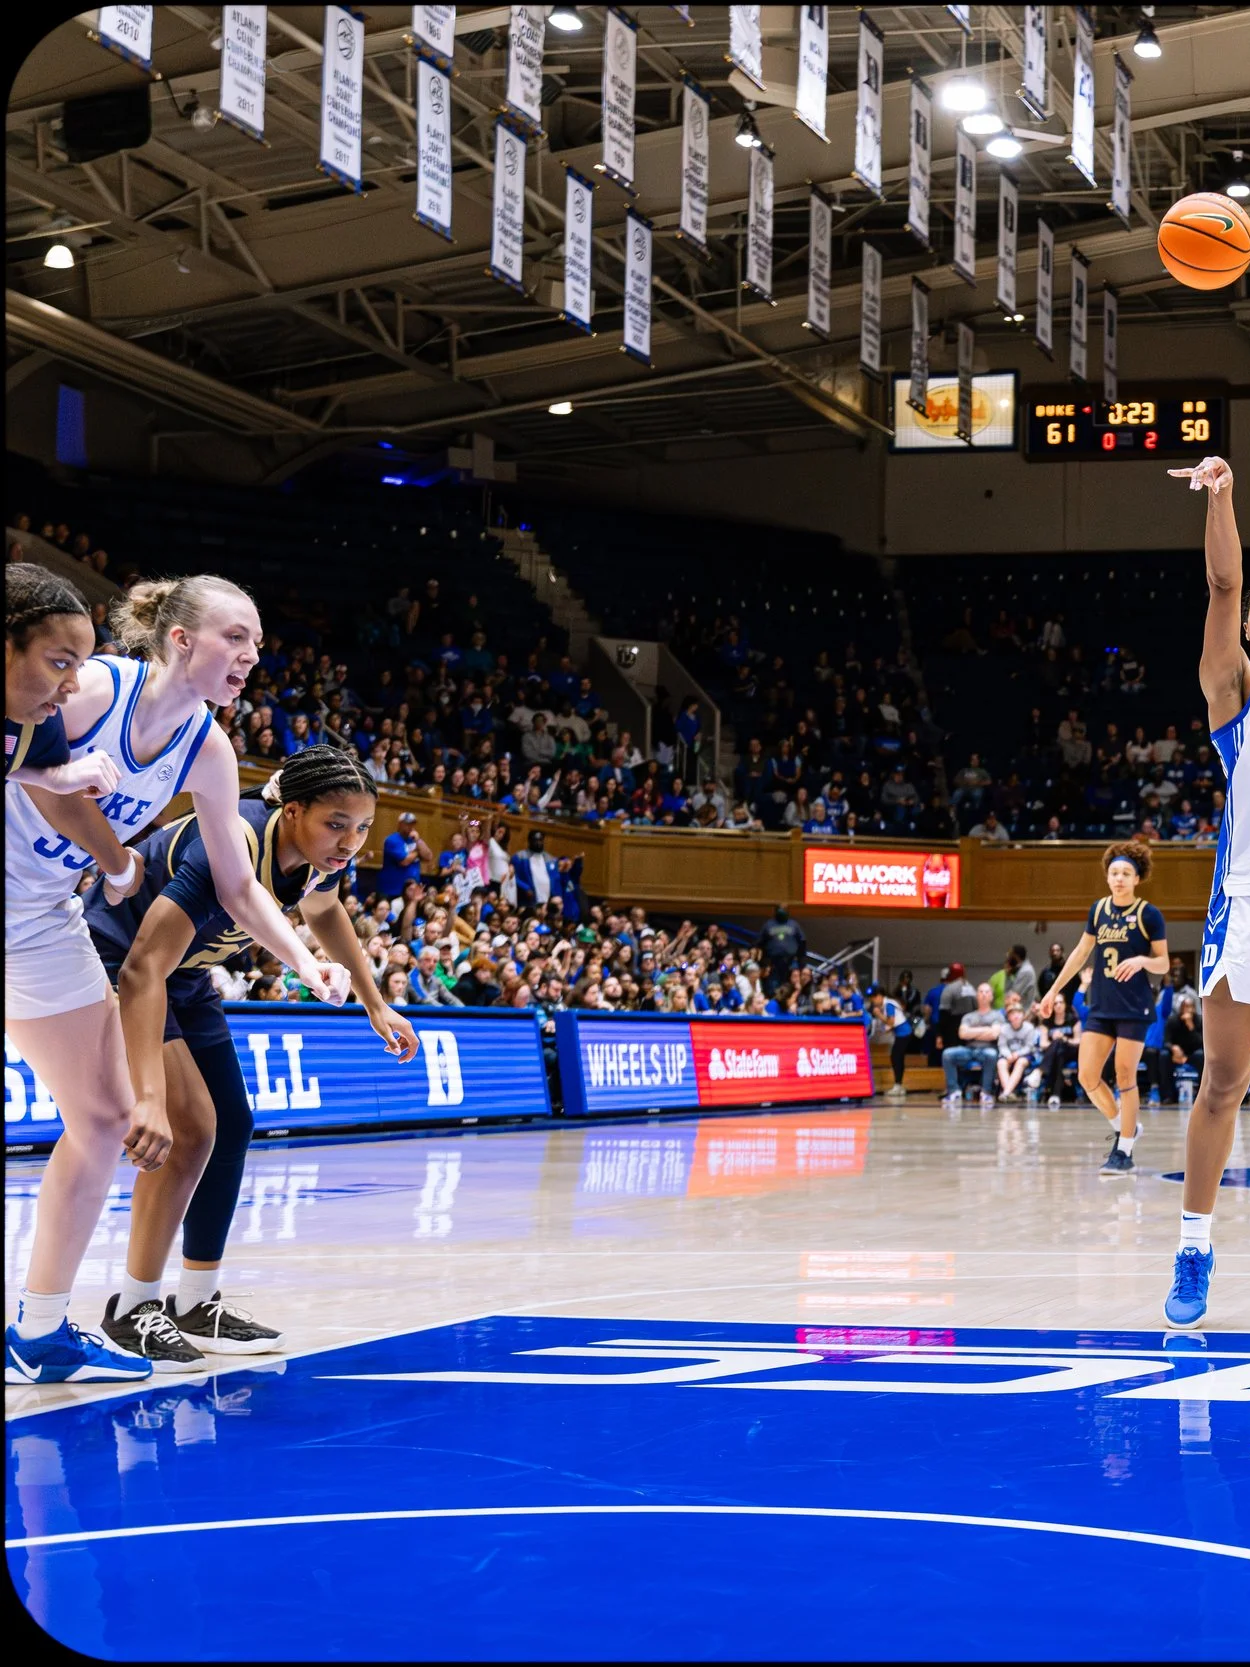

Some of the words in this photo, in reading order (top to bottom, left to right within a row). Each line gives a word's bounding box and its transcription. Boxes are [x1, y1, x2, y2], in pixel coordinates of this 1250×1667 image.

[117, 18, 140, 41] 2010
[1035, 404, 1076, 418] DUKE
[1047, 422, 1076, 445] 61
[1102, 432, 1116, 450] 0
[1144, 431, 1159, 450] 2
[1181, 418, 1210, 442] 50
[813, 862, 853, 882] FAN
[855, 863, 918, 884] WORK
[813, 881, 826, 894] IS
[826, 881, 879, 895] THIRSTY
[879, 883, 918, 897] WORK
[1103, 946, 1119, 979] 3
[1202, 943, 1218, 968] D
[587, 1043, 662, 1087] WHEELS
[664, 1043, 688, 1085] UP
